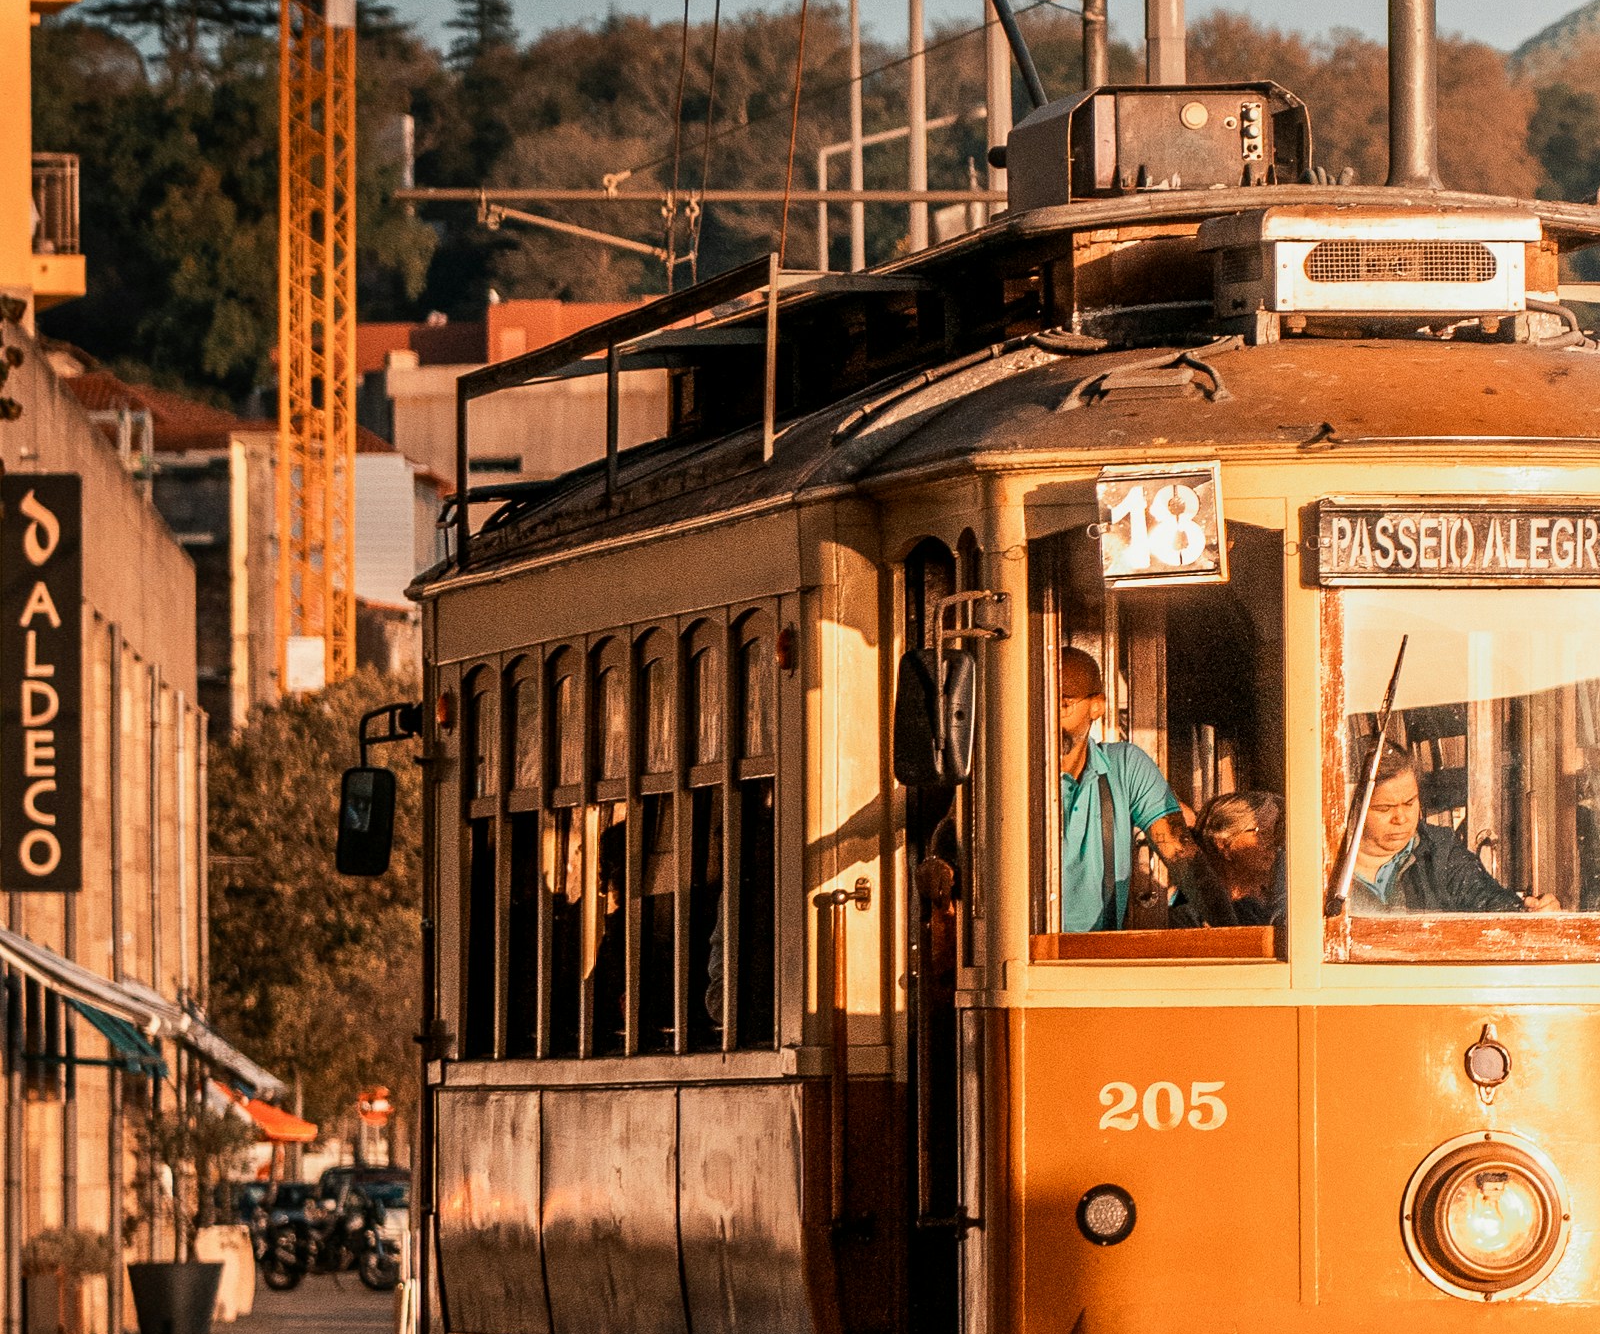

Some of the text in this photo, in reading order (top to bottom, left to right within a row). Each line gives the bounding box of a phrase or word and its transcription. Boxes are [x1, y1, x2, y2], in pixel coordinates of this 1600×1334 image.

[1110, 484, 1206, 568] 18
[1332, 517, 1475, 569] PASSEIO
[19, 581, 61, 876] ALDECO
[1099, 1081, 1228, 1131] 205
